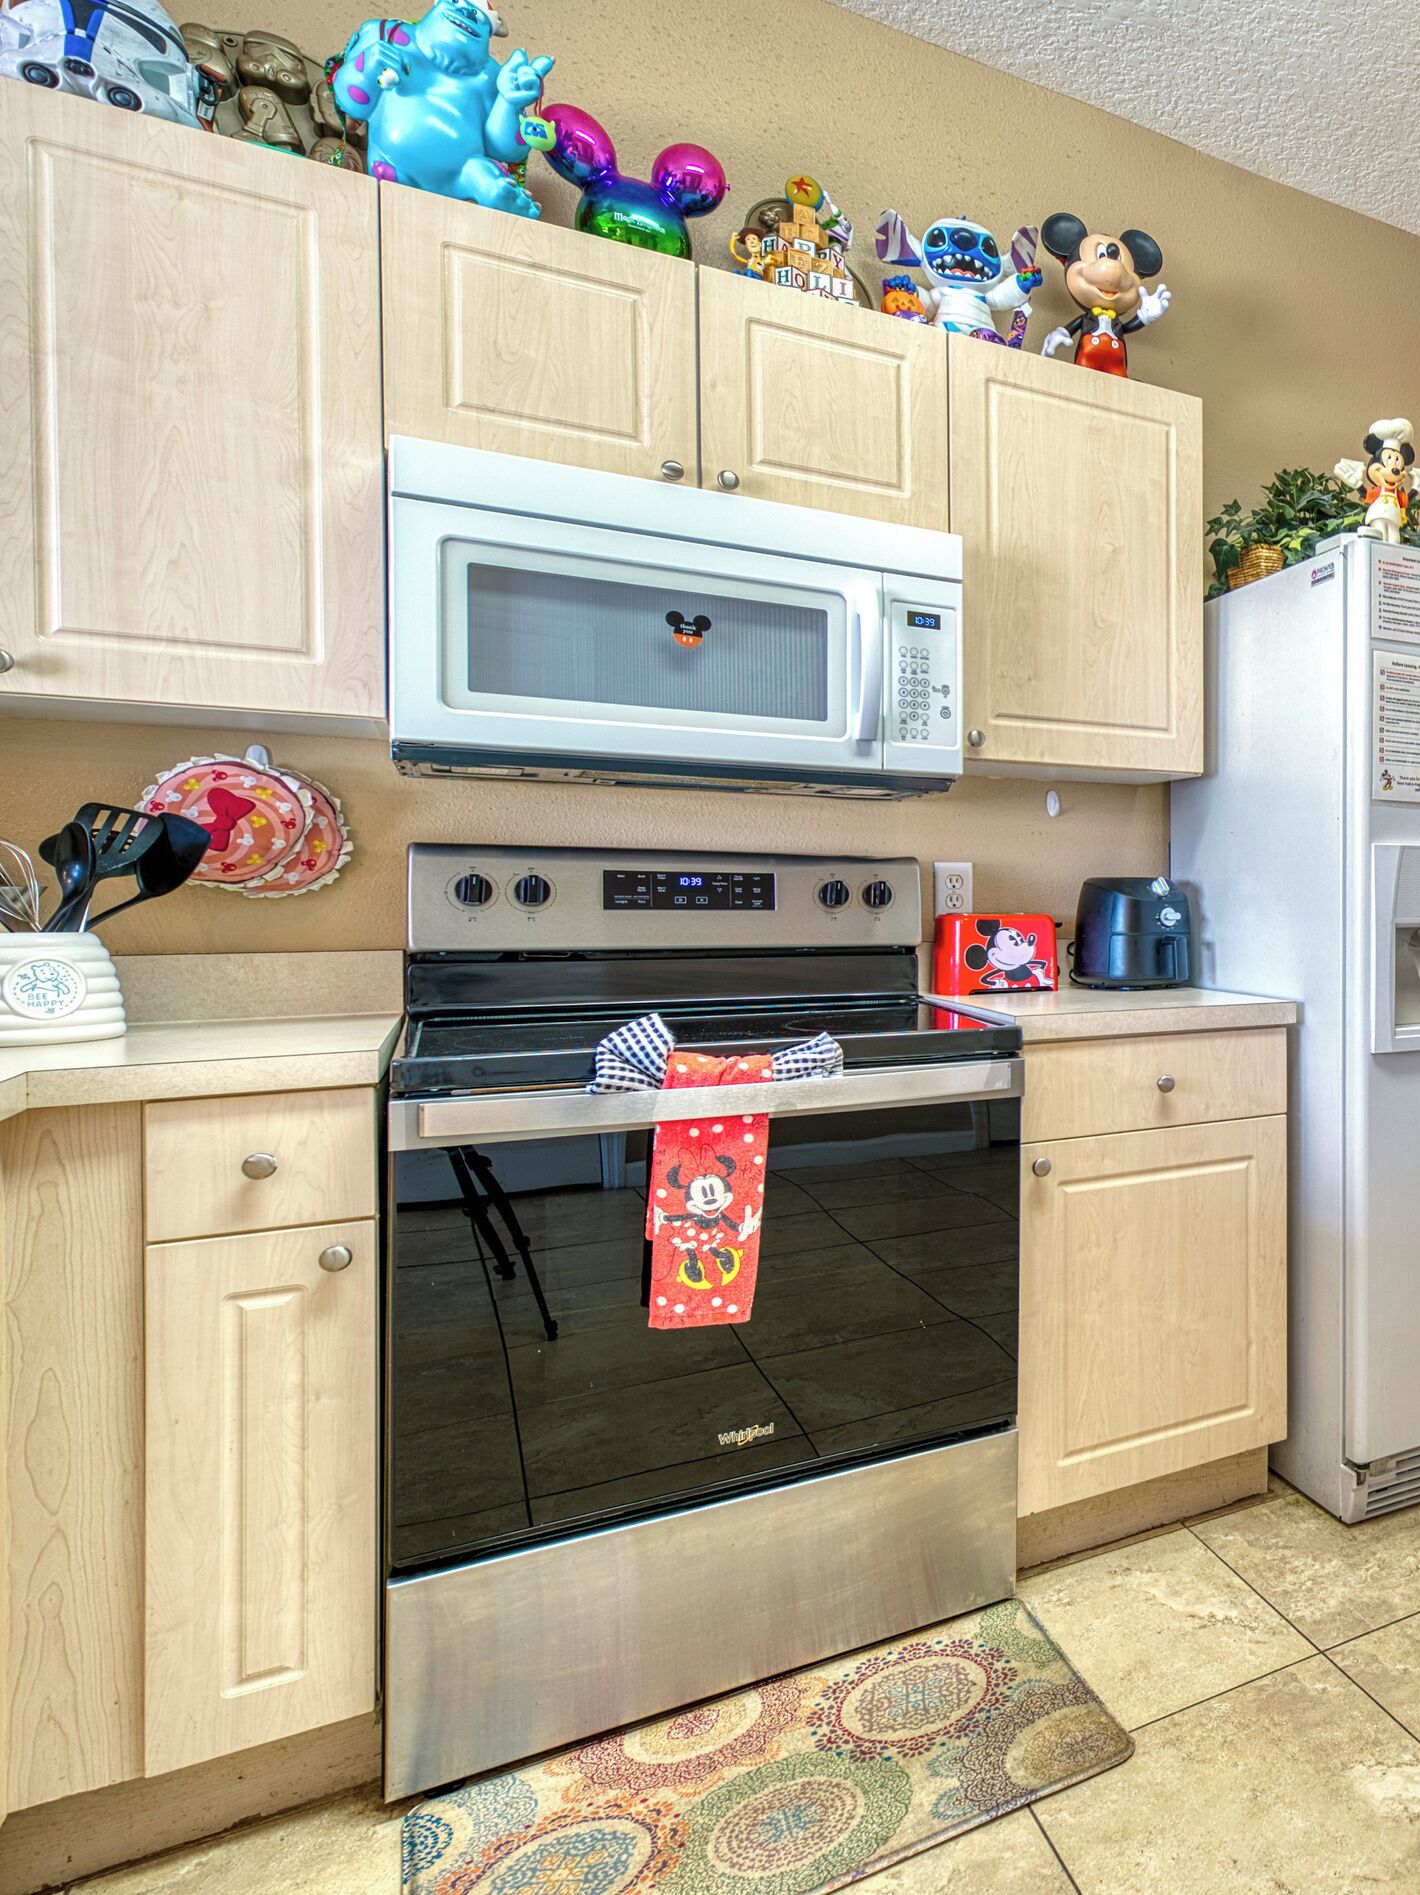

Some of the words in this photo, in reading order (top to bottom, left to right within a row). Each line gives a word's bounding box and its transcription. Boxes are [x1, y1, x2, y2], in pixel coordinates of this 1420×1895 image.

[914, 616, 936, 627] 10:39
[679, 877, 702, 886] 10:39
[26, 999, 65, 1008] HAPPY
[717, 1422, 775, 1446] Whirlpool
